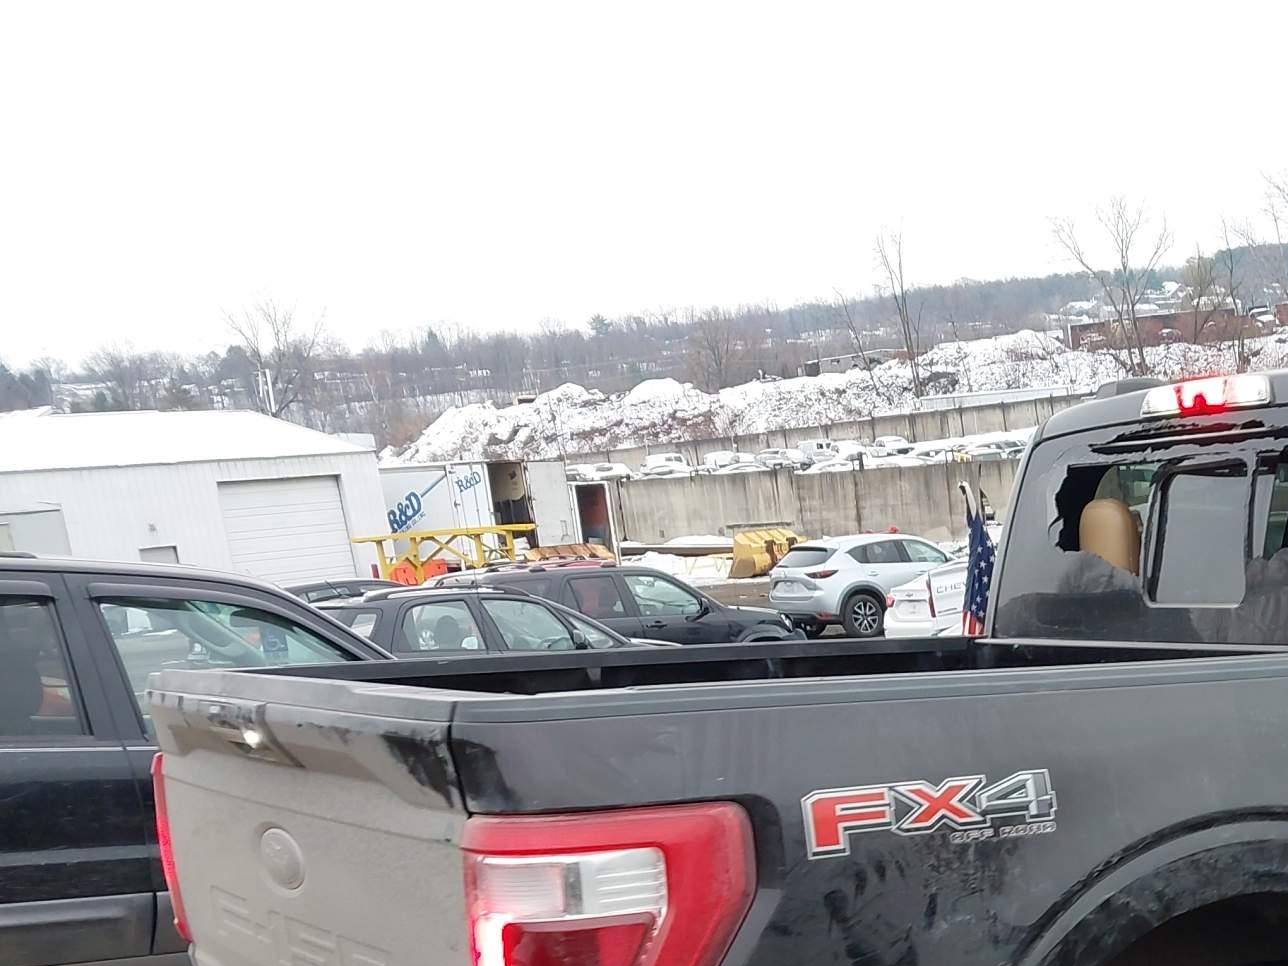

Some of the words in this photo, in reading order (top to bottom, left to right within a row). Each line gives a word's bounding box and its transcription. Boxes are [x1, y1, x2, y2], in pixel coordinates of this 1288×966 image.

[455, 470, 482, 493] R&D
[387, 491, 422, 533] R&D
[800, 768, 1058, 860] FX4
